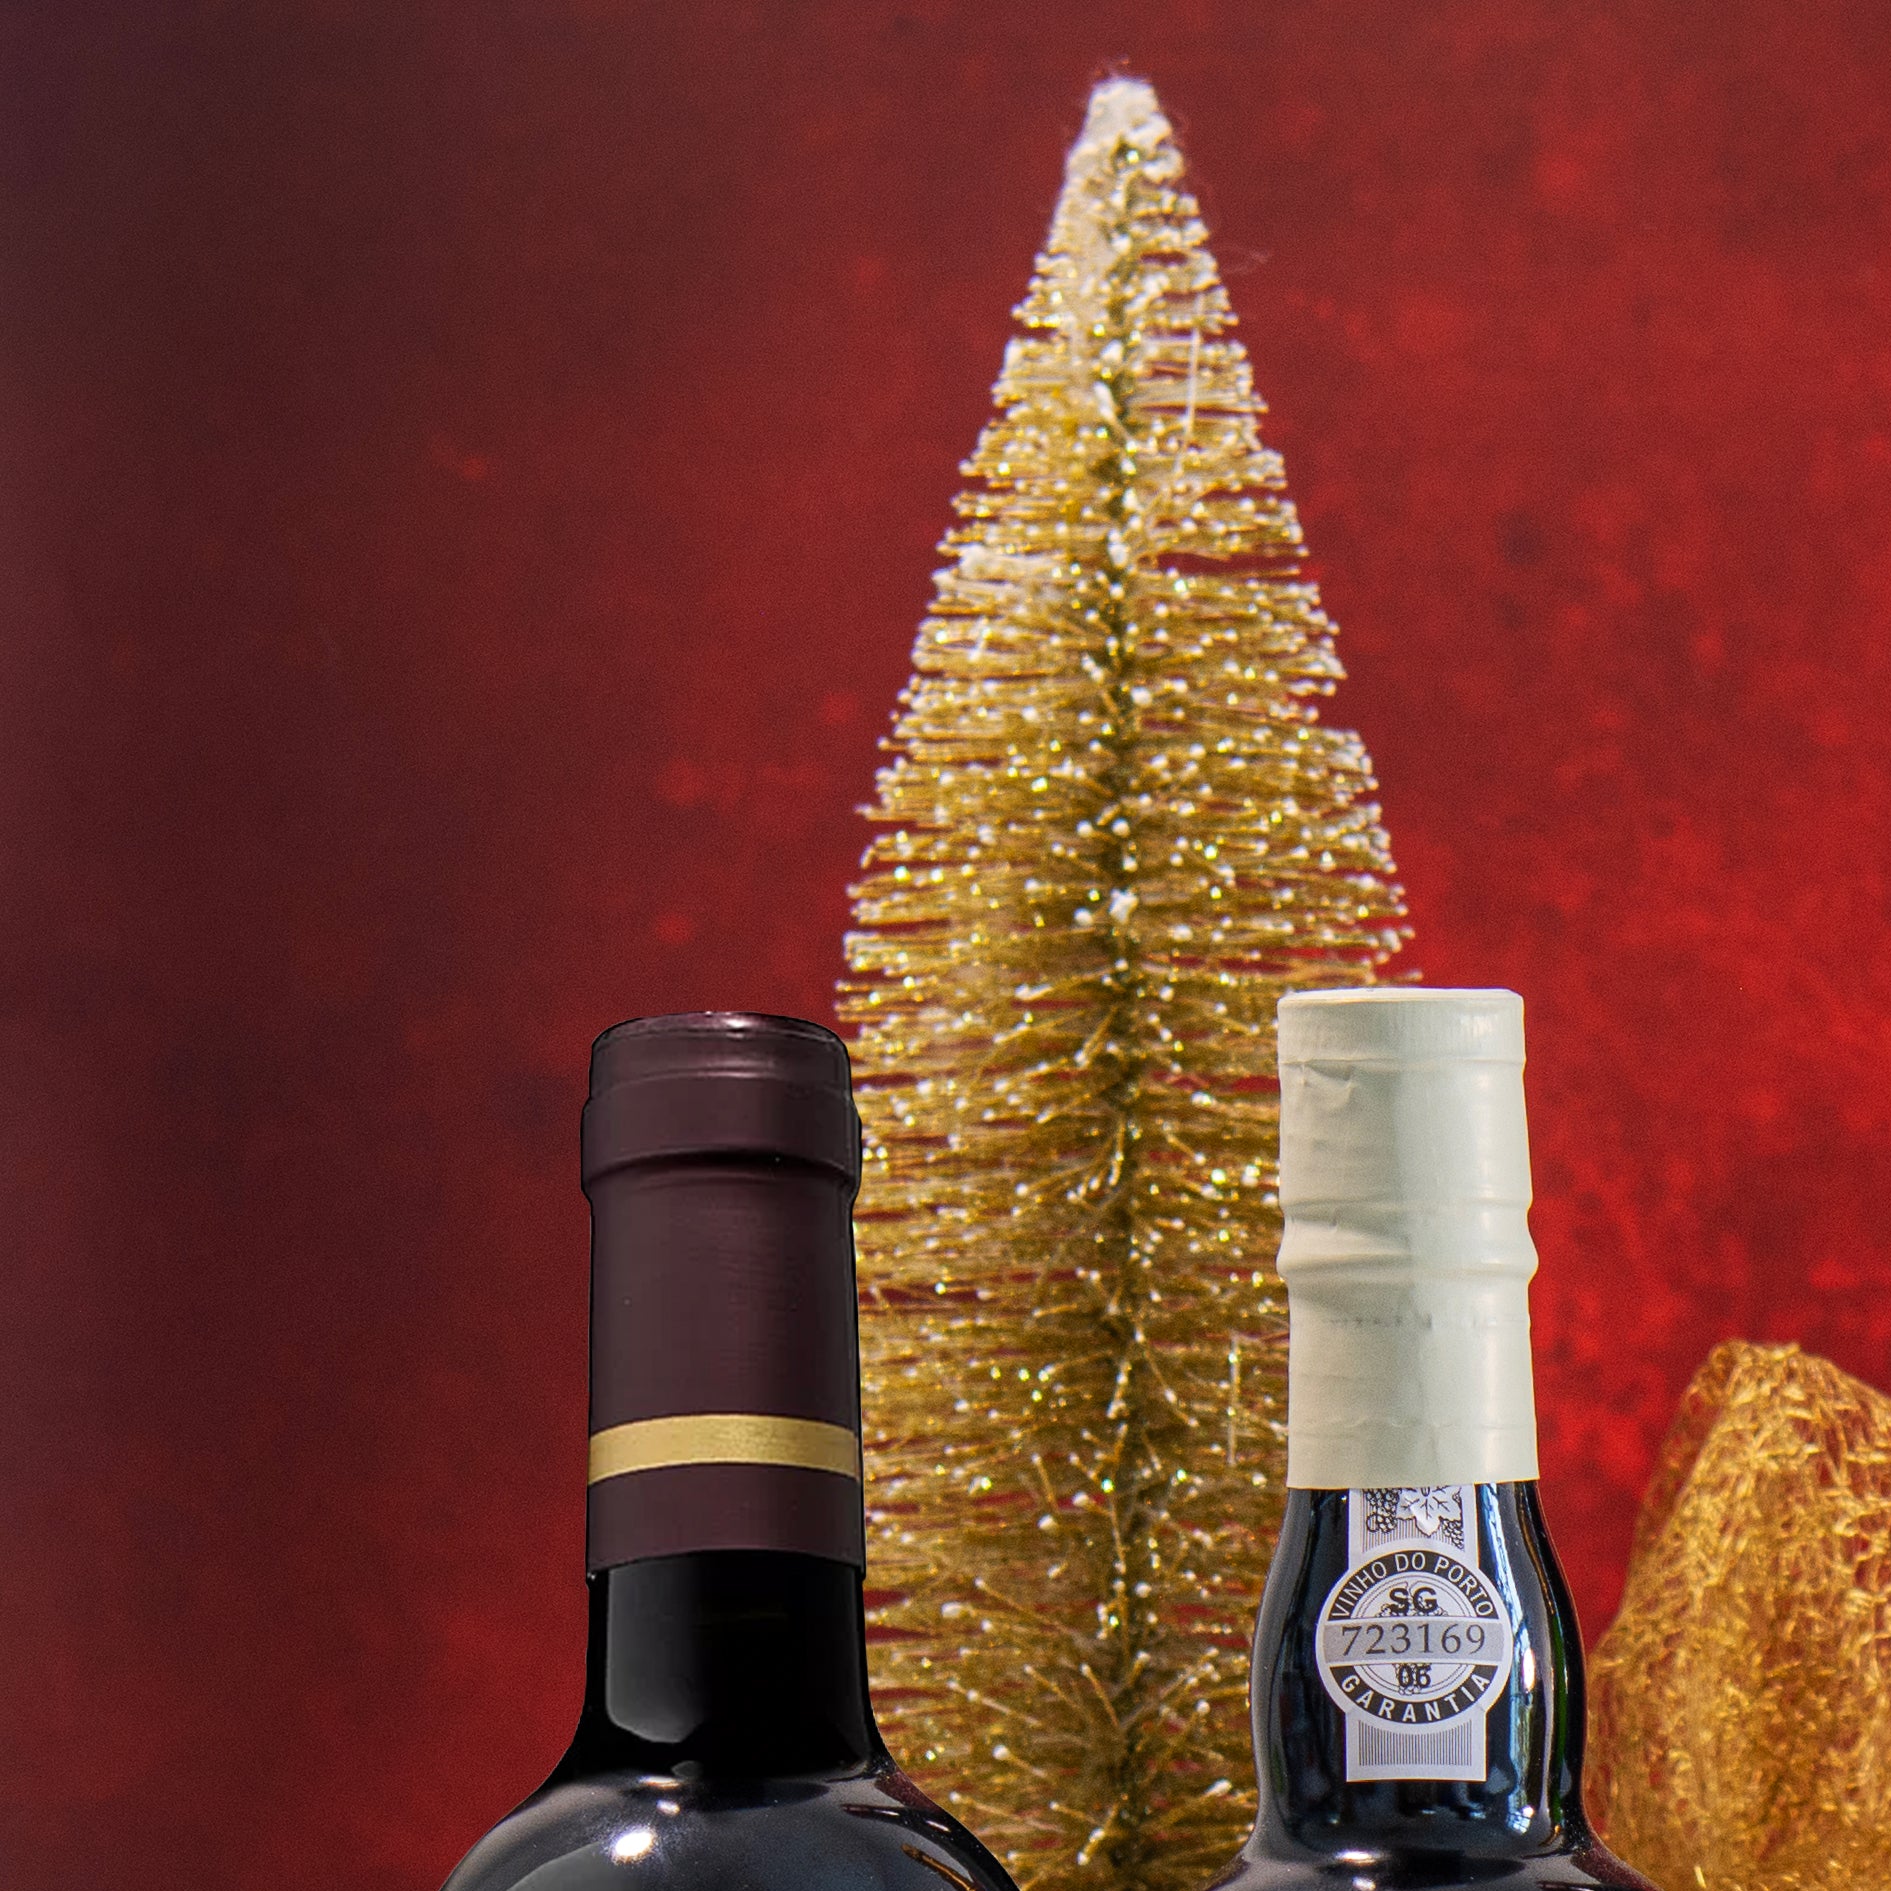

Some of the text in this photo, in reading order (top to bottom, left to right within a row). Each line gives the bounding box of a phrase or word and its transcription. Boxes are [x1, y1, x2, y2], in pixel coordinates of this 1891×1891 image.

[1331, 1551, 1494, 1618] VINHO DO PORTO
[1389, 1587, 1437, 1616] SG
[1342, 1623, 1486, 1655] 723169
[1341, 1674, 1491, 1723] GARANTIA
